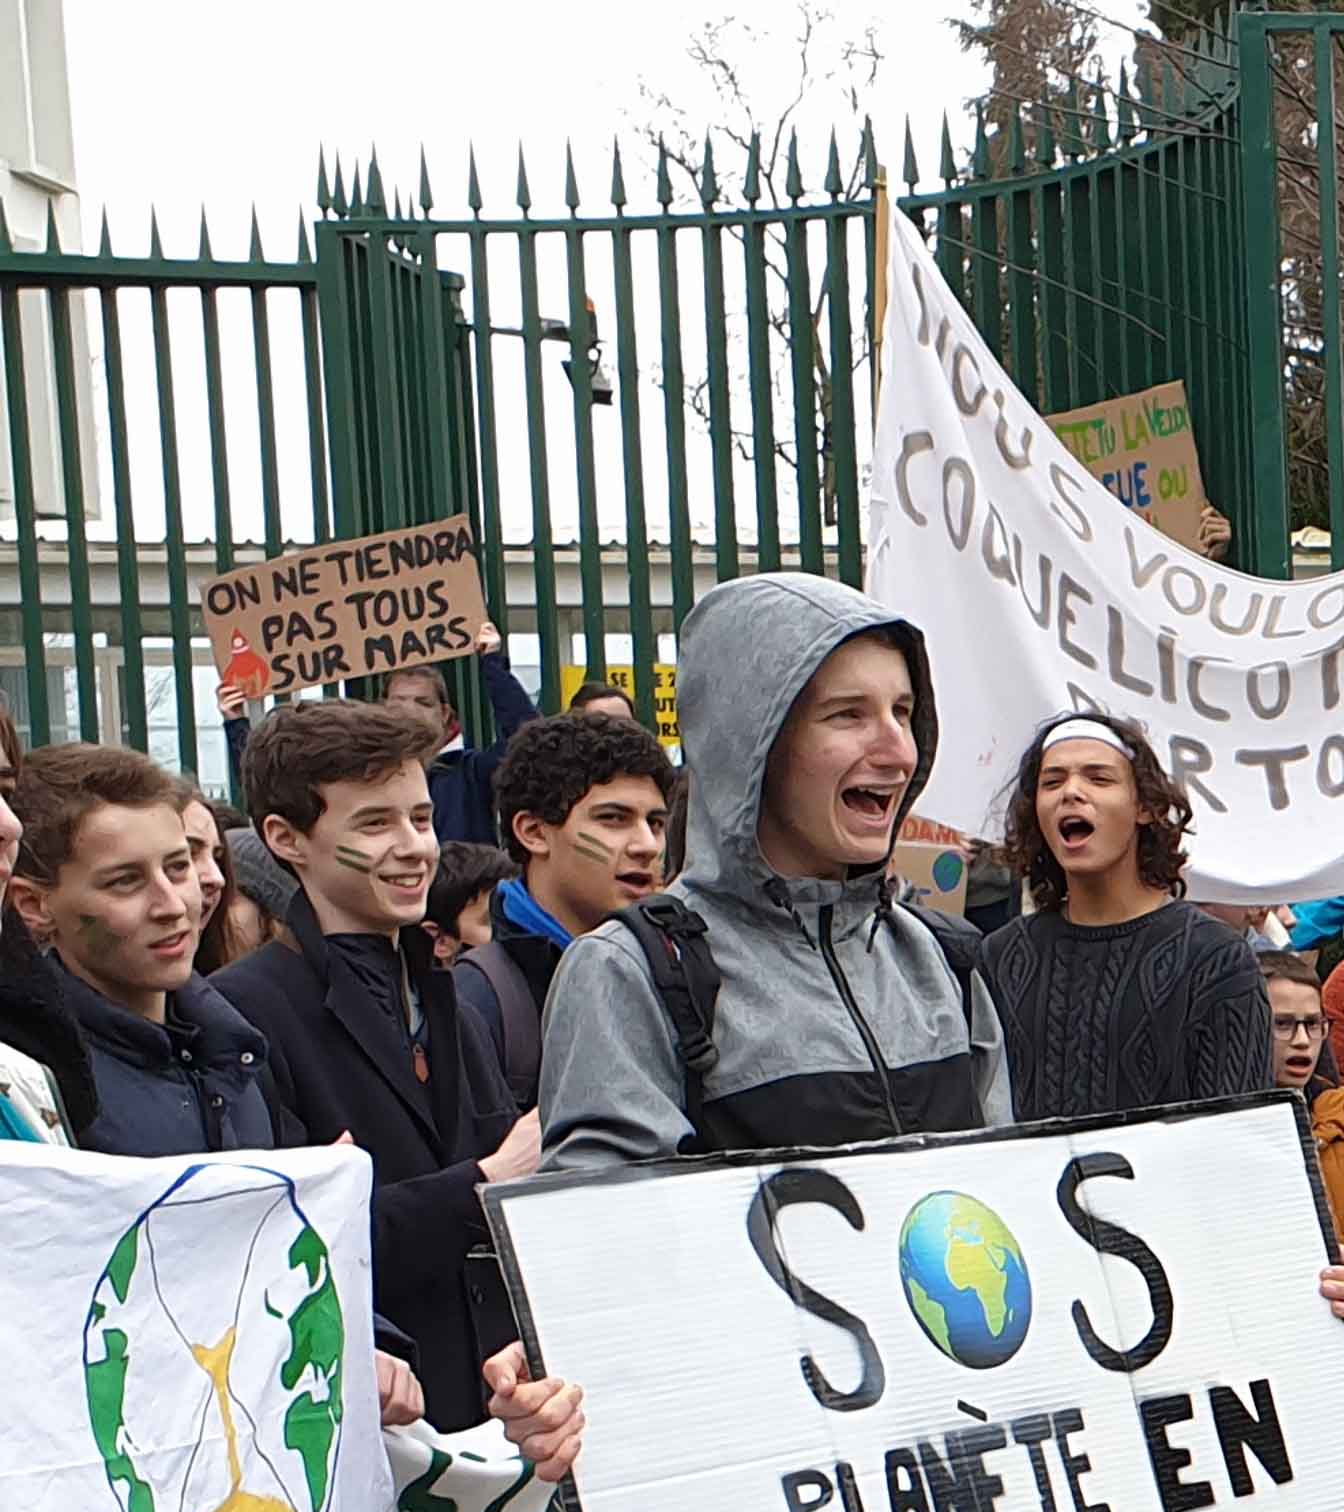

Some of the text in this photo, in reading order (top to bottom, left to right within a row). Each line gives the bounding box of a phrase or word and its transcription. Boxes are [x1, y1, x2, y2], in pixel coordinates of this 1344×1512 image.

[207, 526, 474, 615] ON NE TIENDRA
[262, 580, 449, 654] PAS TOUS
[271, 616, 472, 690] SUR MARS
